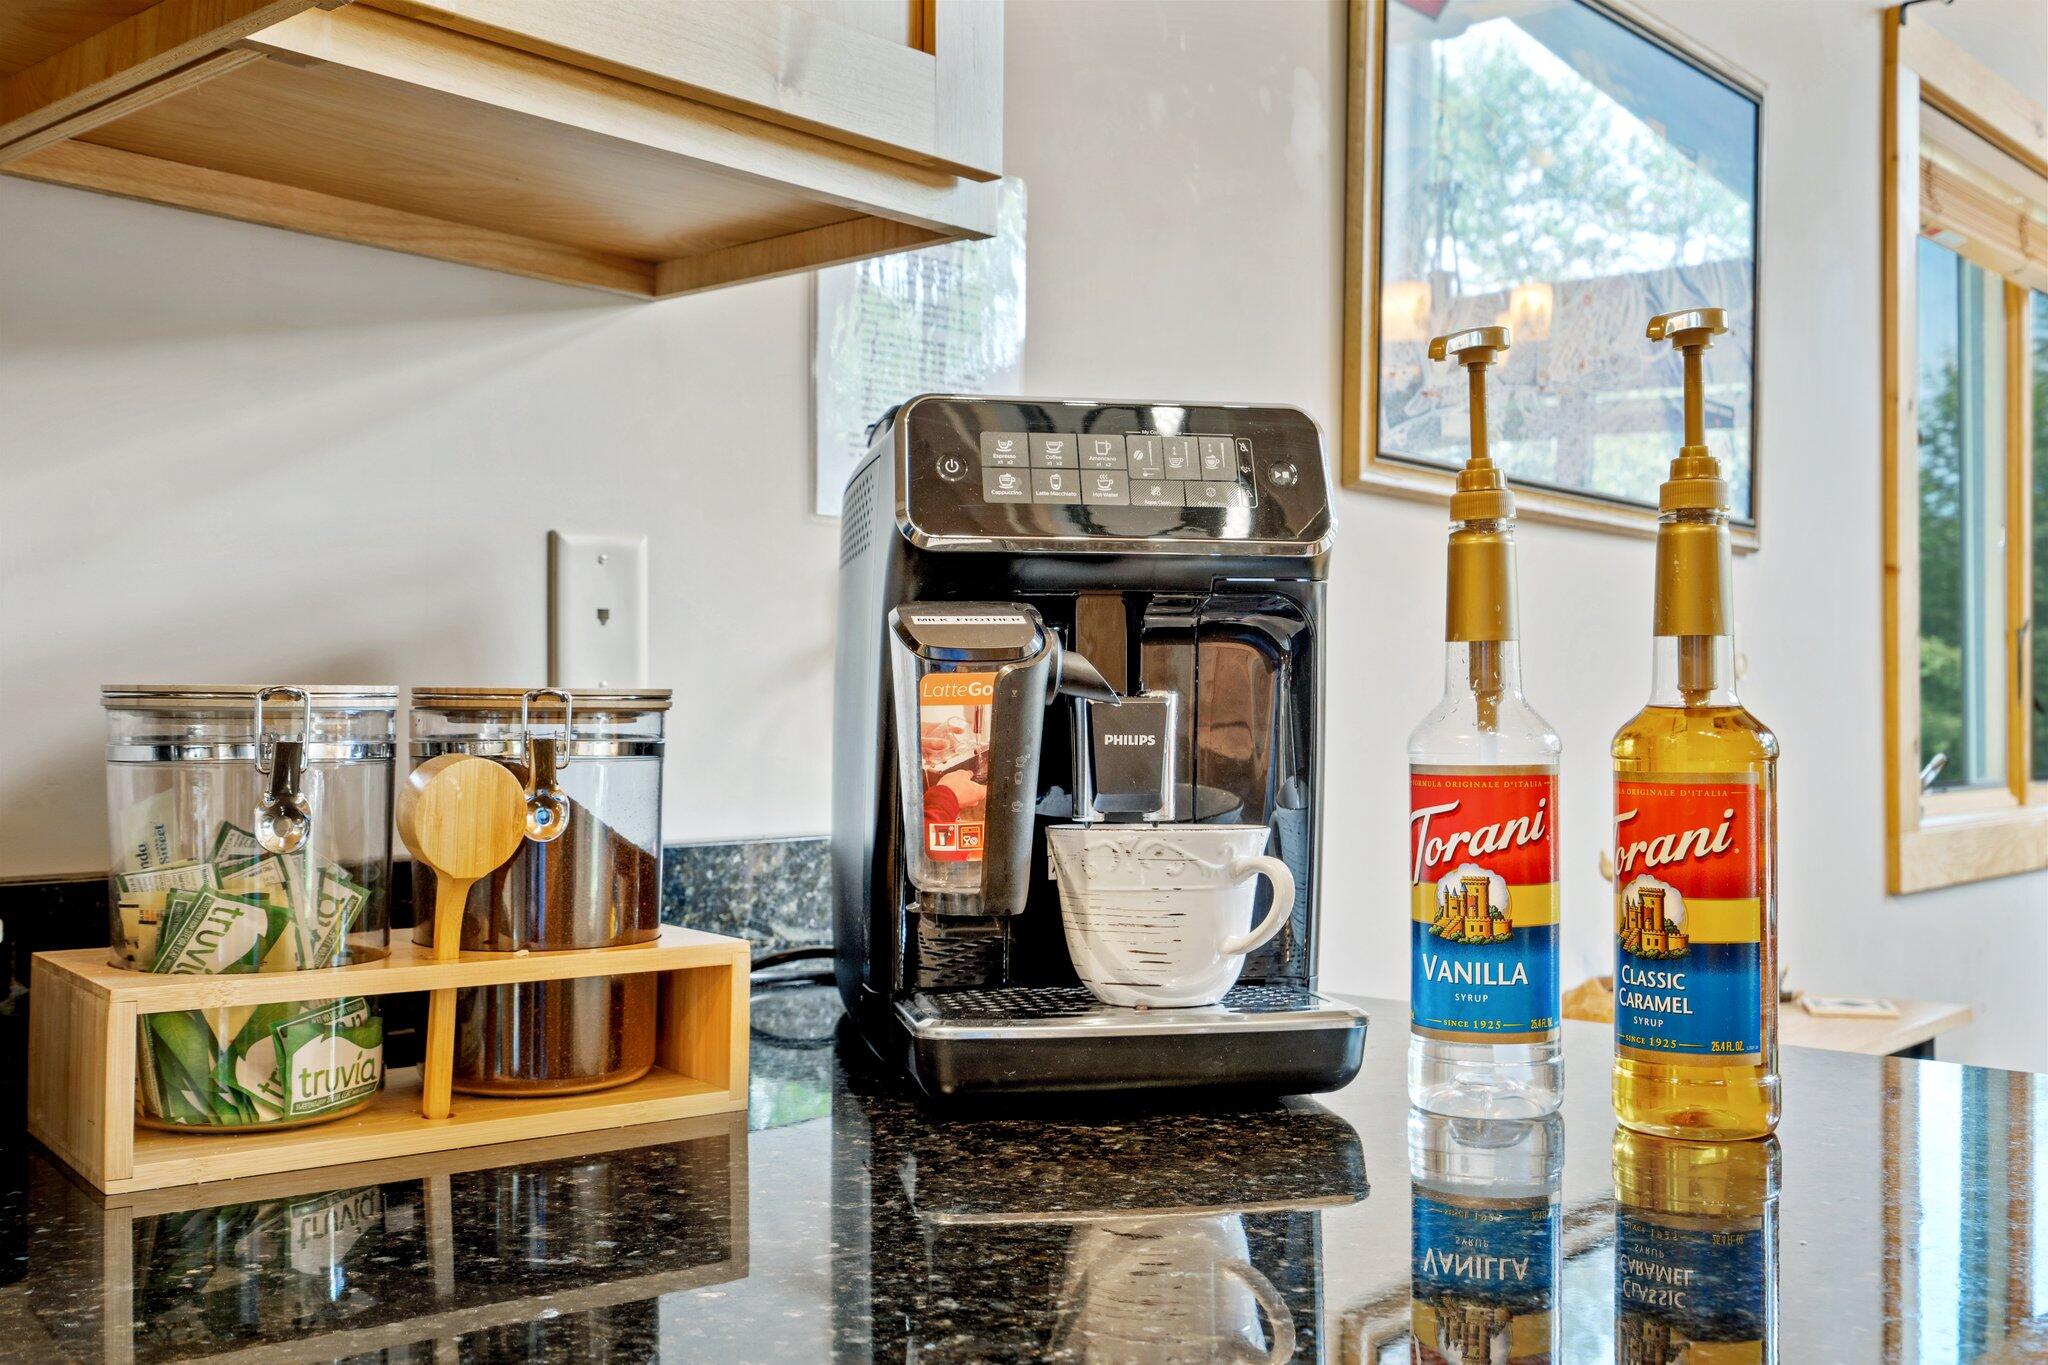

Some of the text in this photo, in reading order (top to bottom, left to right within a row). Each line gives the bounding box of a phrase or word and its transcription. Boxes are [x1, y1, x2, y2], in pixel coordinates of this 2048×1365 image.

[923, 681, 993, 697] LatteGo
[1104, 733, 1156, 747] PHILIPS
[1445, 780, 1500, 788] ORIGINALE
[1504, 780, 1542, 788] D'ITALIA
[1626, 788, 1676, 797] ORIGINALE
[1680, 789, 1728, 797] D'ITALIA
[1409, 797, 1547, 887] Torani
[1422, 952, 1529, 986] VANILLA
[1621, 964, 1686, 991] CLASSIC
[1454, 993, 1489, 1003] SYRUP
[1619, 987, 1693, 1015] CARAMEL
[1443, 1019, 1501, 1029] SINCE 1925
[1633, 1016, 1664, 1028] SYRUP
[1625, 1035, 1677, 1049] SINCE 1925
[1711, 1041, 1725, 1052] 25.4
